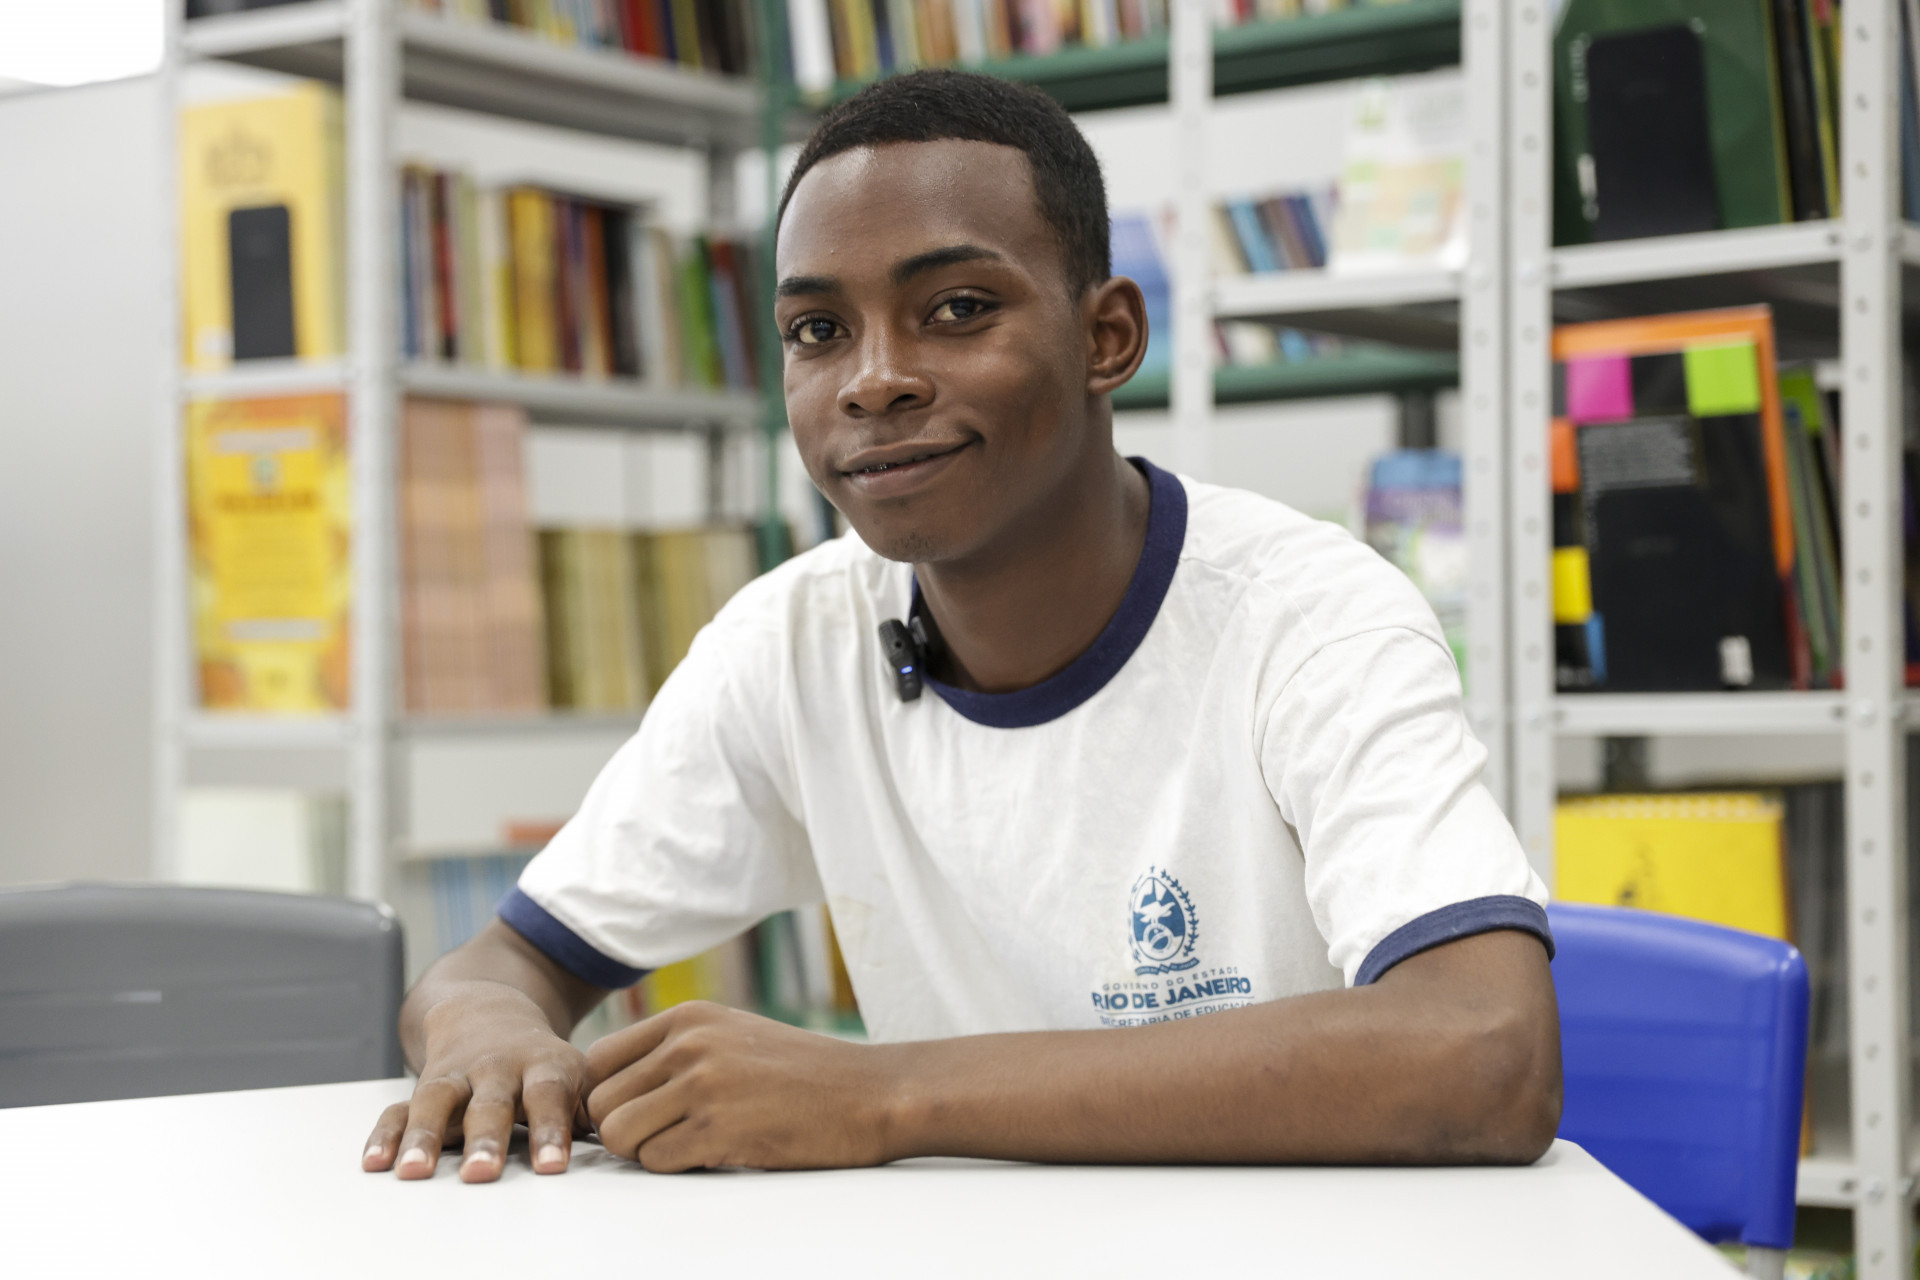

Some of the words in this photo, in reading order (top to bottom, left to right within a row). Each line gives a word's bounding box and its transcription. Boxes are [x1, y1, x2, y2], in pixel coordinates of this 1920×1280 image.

[1166, 976, 1185, 987] DO
[1192, 966, 1239, 981] ESTADO
[1091, 991, 1128, 1010] RIO
[1132, 993, 1160, 1009] DE
[1164, 977, 1252, 1005] JANEIRO
[1174, 1008, 1191, 1021] DE
